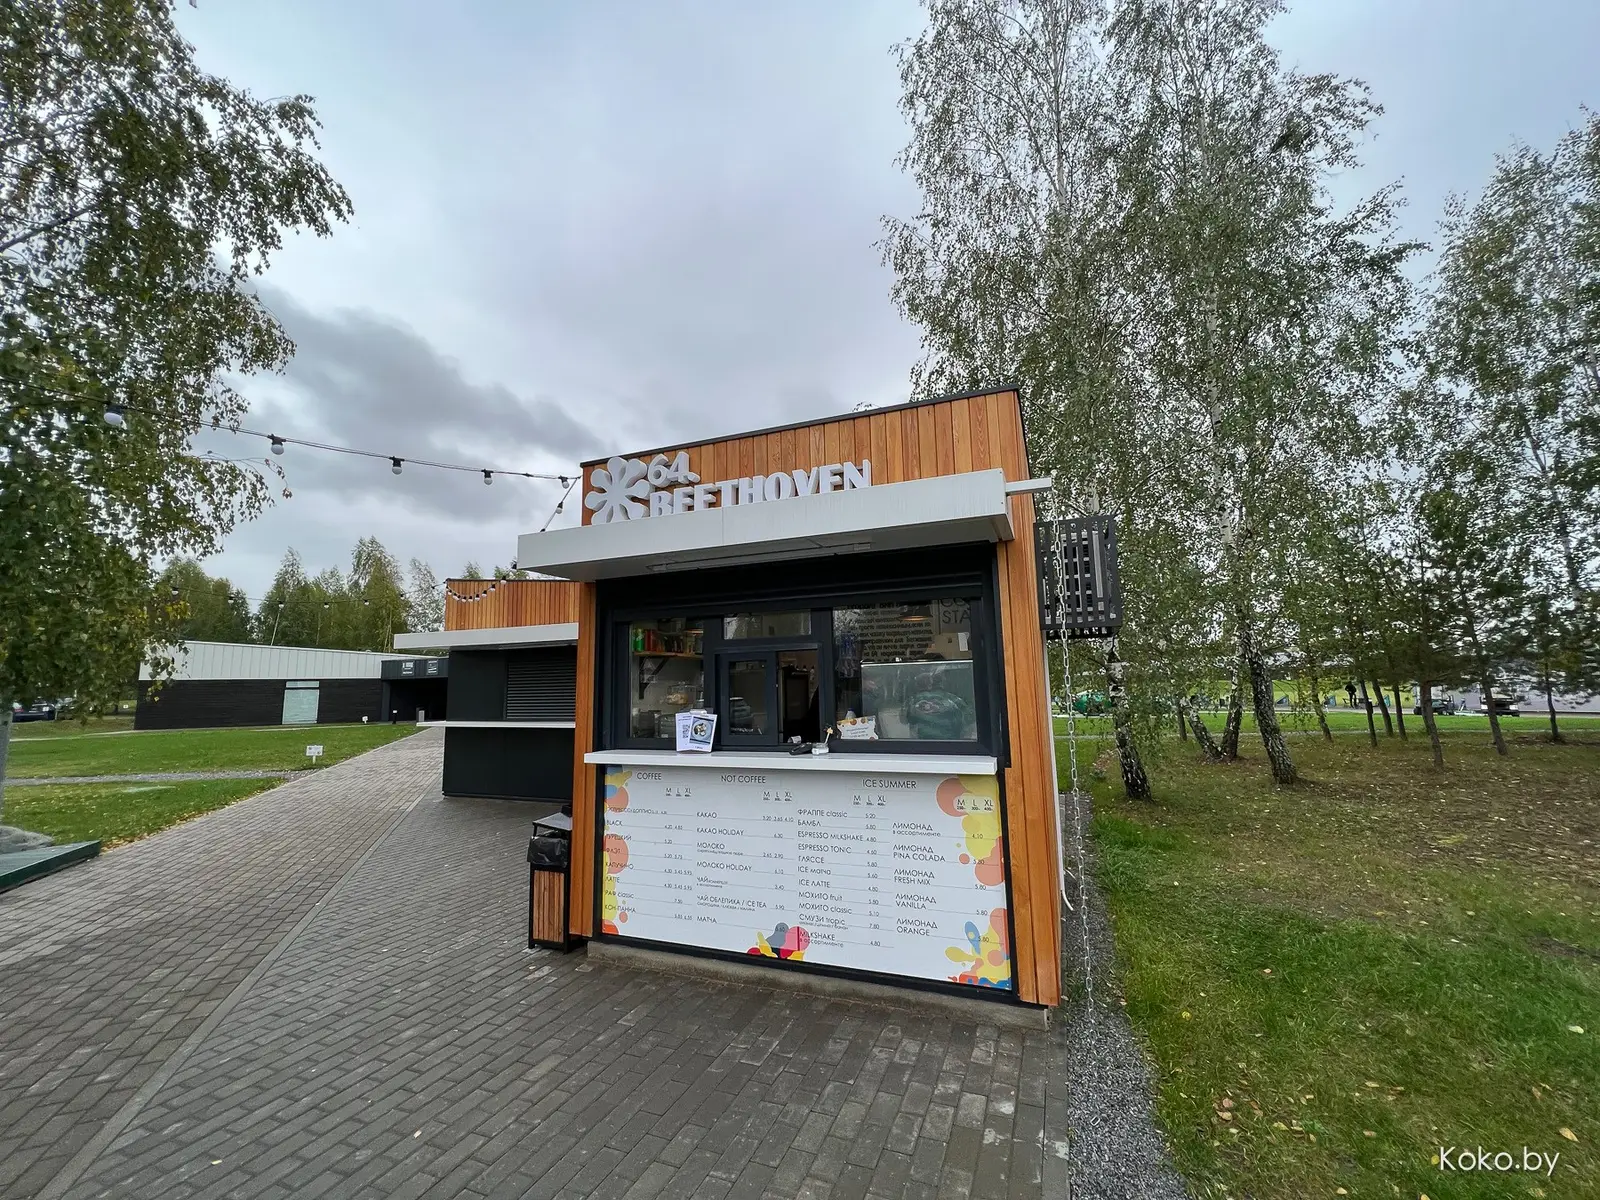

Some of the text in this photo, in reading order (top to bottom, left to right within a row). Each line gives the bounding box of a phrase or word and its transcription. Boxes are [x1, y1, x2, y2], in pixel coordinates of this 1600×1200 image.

[650, 460, 871, 518] BEETHOVEN
[636, 772, 662, 780] COFFEE
[721, 775, 766, 784] NOT COFFEE
[862, 779, 917, 789] ICE SUMMER
[798, 809, 825, 817] ФРАППЕ
[826, 810, 848, 818] classic
[798, 819, 822, 827] БАМБЛ
[892, 823, 933, 831] ЛИМОНАД
[798, 831, 829, 839] ESPRESSO
[830, 834, 864, 842] MILKSHAKE
[798, 843, 829, 852] ESPRESSO
[831, 846, 852, 854] TONIC
[893, 845, 934, 854] ЛИМОНАД
[798, 856, 825, 864] ГЛЯССЕ
[894, 852, 910, 860] PINA
[912, 854, 946, 862] COLADA
[726, 864, 752, 872] HOLIDAY
[798, 866, 808, 874] ICE
[894, 869, 935, 879] ЛИМОНАД
[894, 876, 916, 884] FRESH
[799, 891, 828, 901] МОХИТО
[895, 893, 937, 904] ЛИМОНАД
[799, 903, 829, 912] МОХИТО
[830, 906, 852, 914] classic
[896, 901, 926, 910] VANILLA
[799, 913, 825, 923] СМУЗИ
[896, 918, 938, 929] ЛИМОНАД
[800, 931, 835, 941] MILKSHAKE
[897, 926, 930, 936] ORANGE
